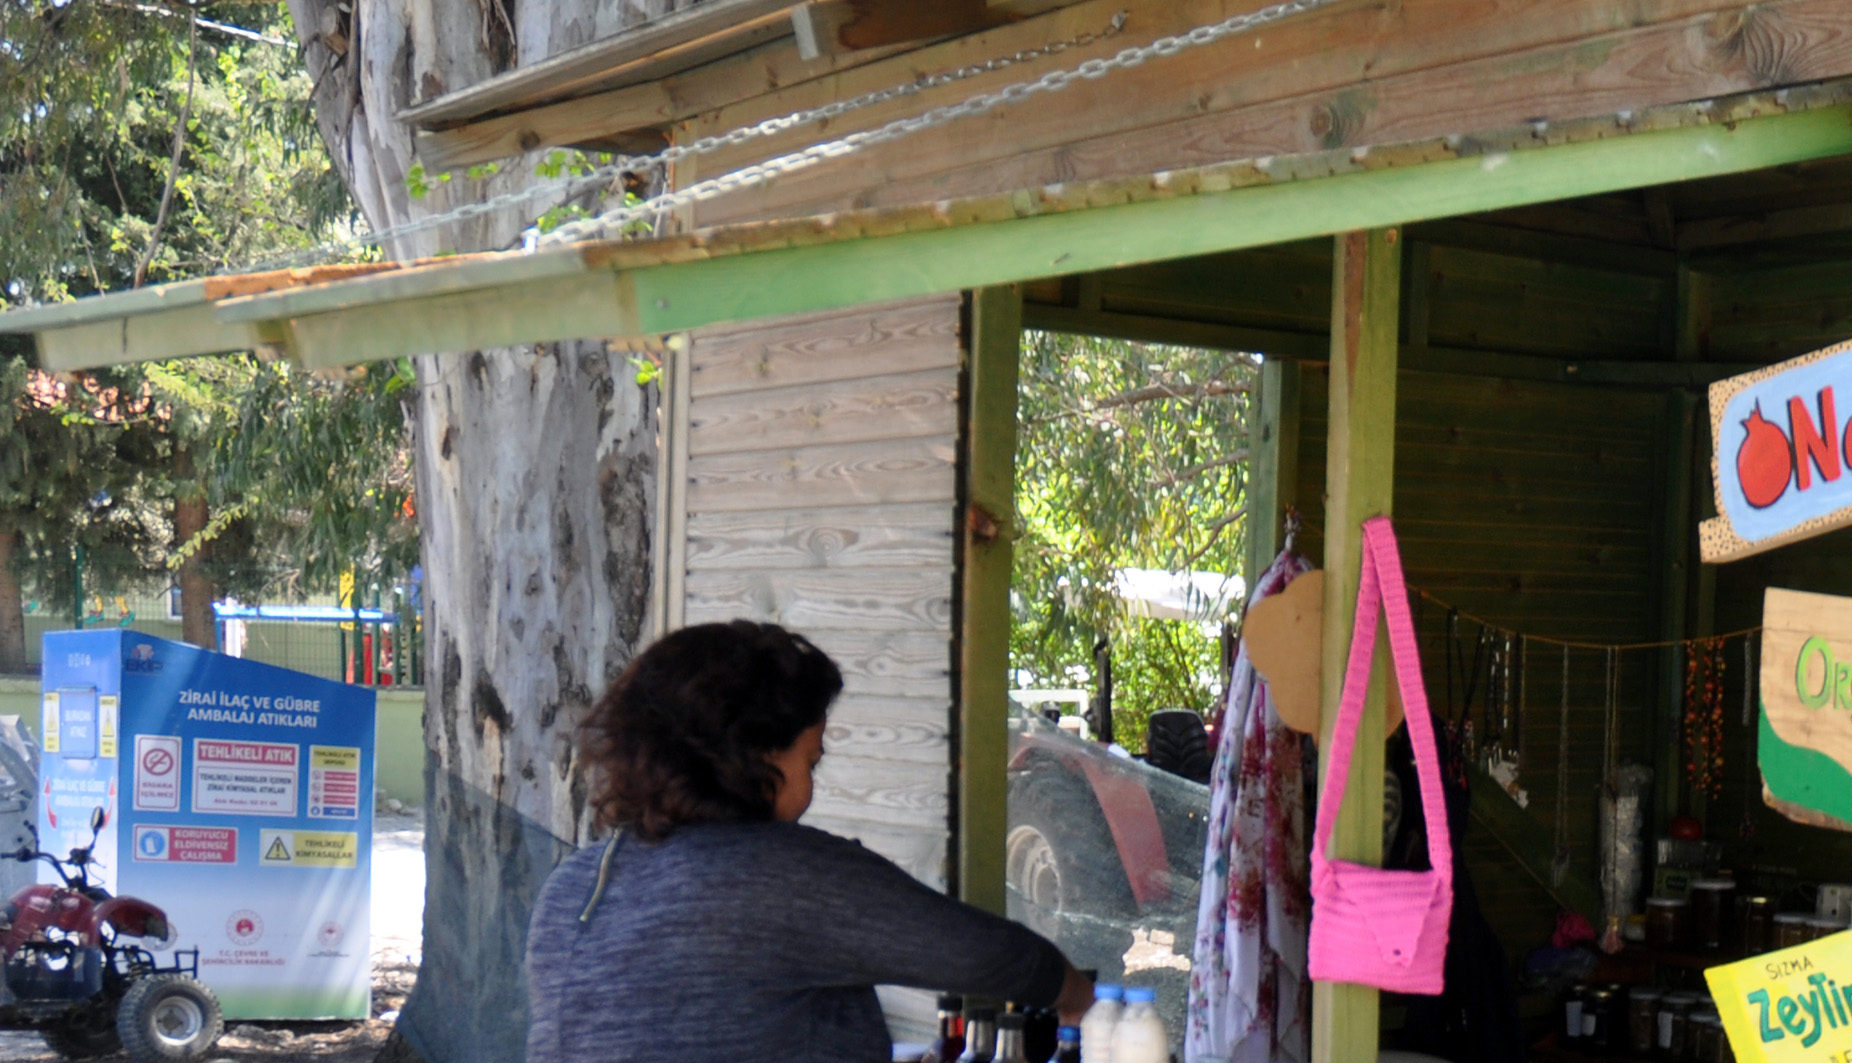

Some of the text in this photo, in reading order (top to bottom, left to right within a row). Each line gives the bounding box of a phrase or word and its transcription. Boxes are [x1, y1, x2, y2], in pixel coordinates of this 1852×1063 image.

[179, 689, 321, 713] ZİRAİ İLAÇ VE GÜBRE
[187, 709, 318, 728] AMBALAJ ATIKLARI
[199, 744, 293, 762] TEHLİKELİ ATIK
[174, 830, 229, 840] KORUYUCU
[174, 839, 229, 850] ELDİVENSİZ
[180, 850, 222, 861] ÇALIŞMA
[1765, 955, 1815, 980] SIZMA
